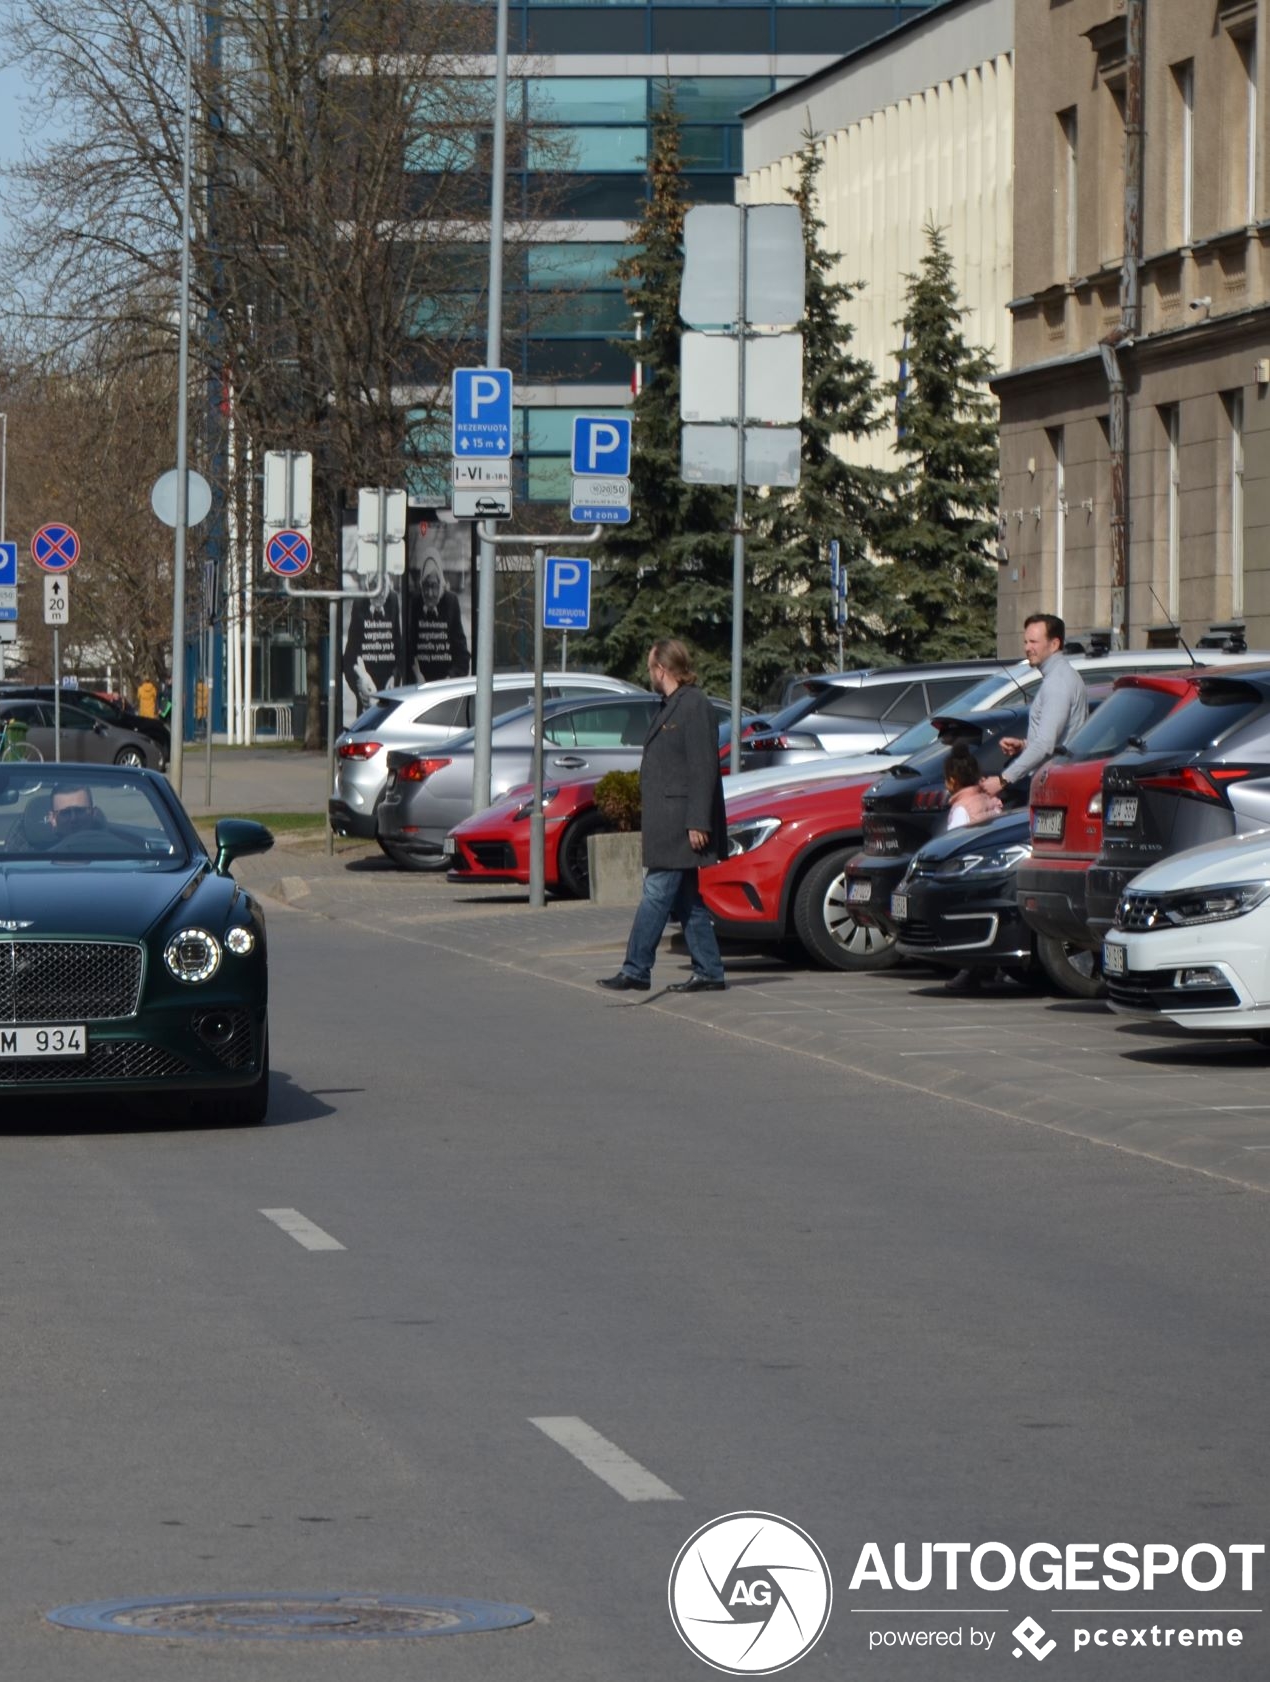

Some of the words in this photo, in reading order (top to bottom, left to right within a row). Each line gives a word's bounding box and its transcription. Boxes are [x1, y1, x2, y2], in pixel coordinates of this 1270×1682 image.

[471, 375, 501, 419] P
[457, 423, 508, 432] REZERVUOTA
[473, 438, 484, 448] 15
[485, 440, 494, 448] m
[588, 423, 620, 469] P
[455, 467, 482, 480] I-VI
[613, 485, 625, 494] 50
[583, 510, 592, 519] M
[596, 512, 619, 520] zona
[553, 562, 581, 599] P
[49, 598, 65, 610] 20
[36, 1029, 80, 1051] 934
